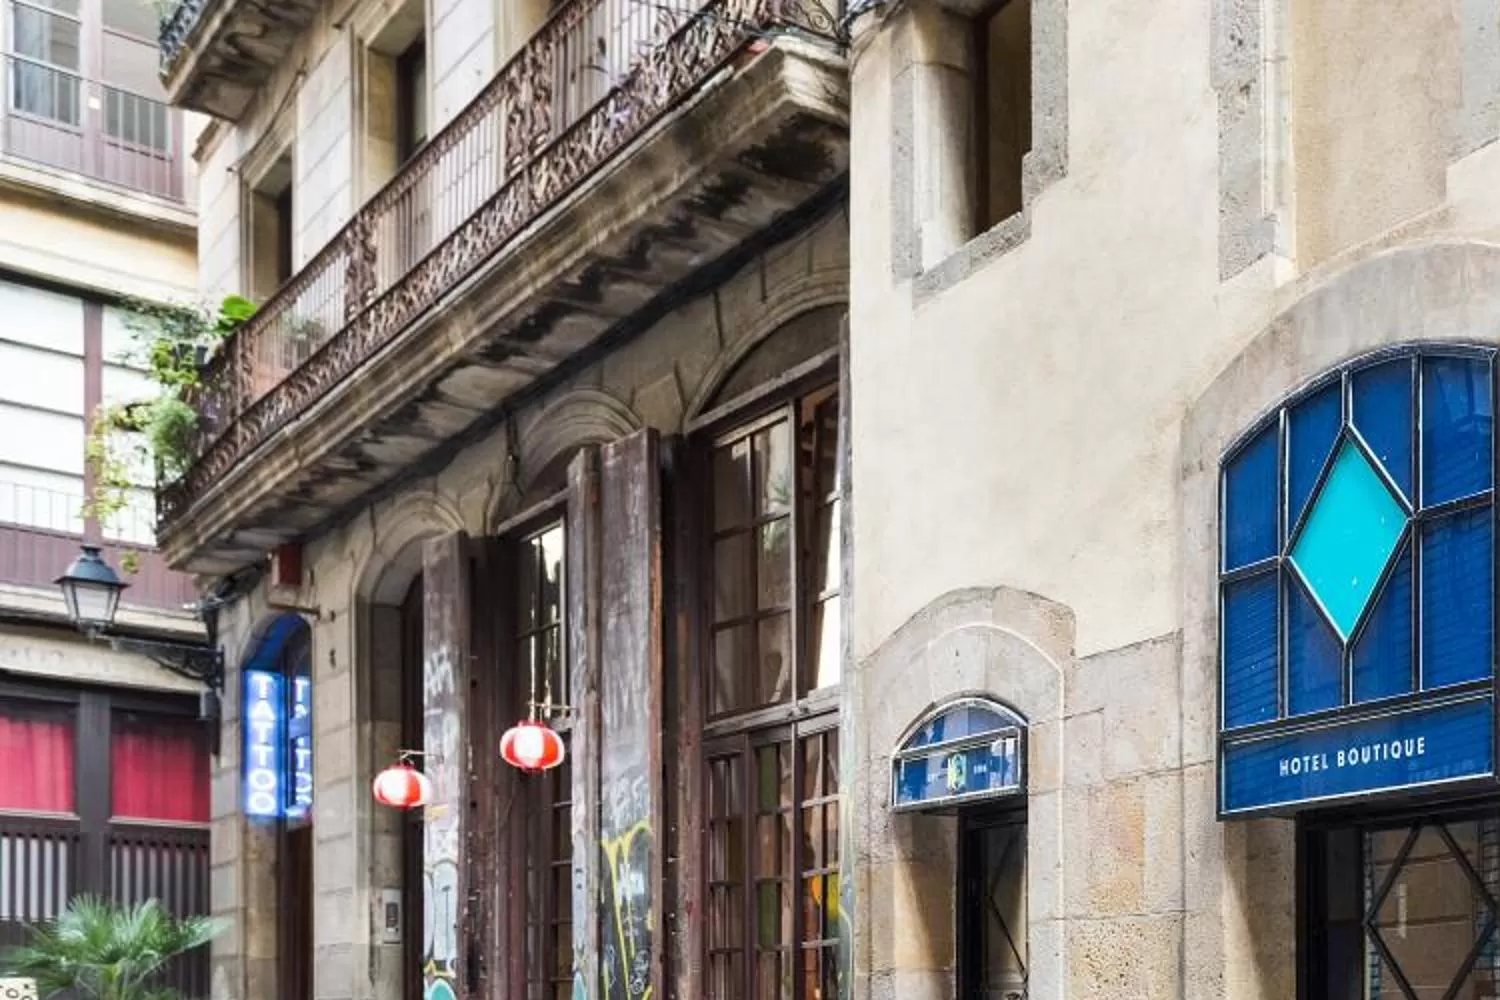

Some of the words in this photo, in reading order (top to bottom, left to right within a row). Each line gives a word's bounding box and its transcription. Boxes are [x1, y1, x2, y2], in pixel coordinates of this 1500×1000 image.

[249, 674, 277, 814] TATTOO
[1279, 753, 1329, 777] HOTEL
[1337, 737, 1425, 767] BOUTIQUE
